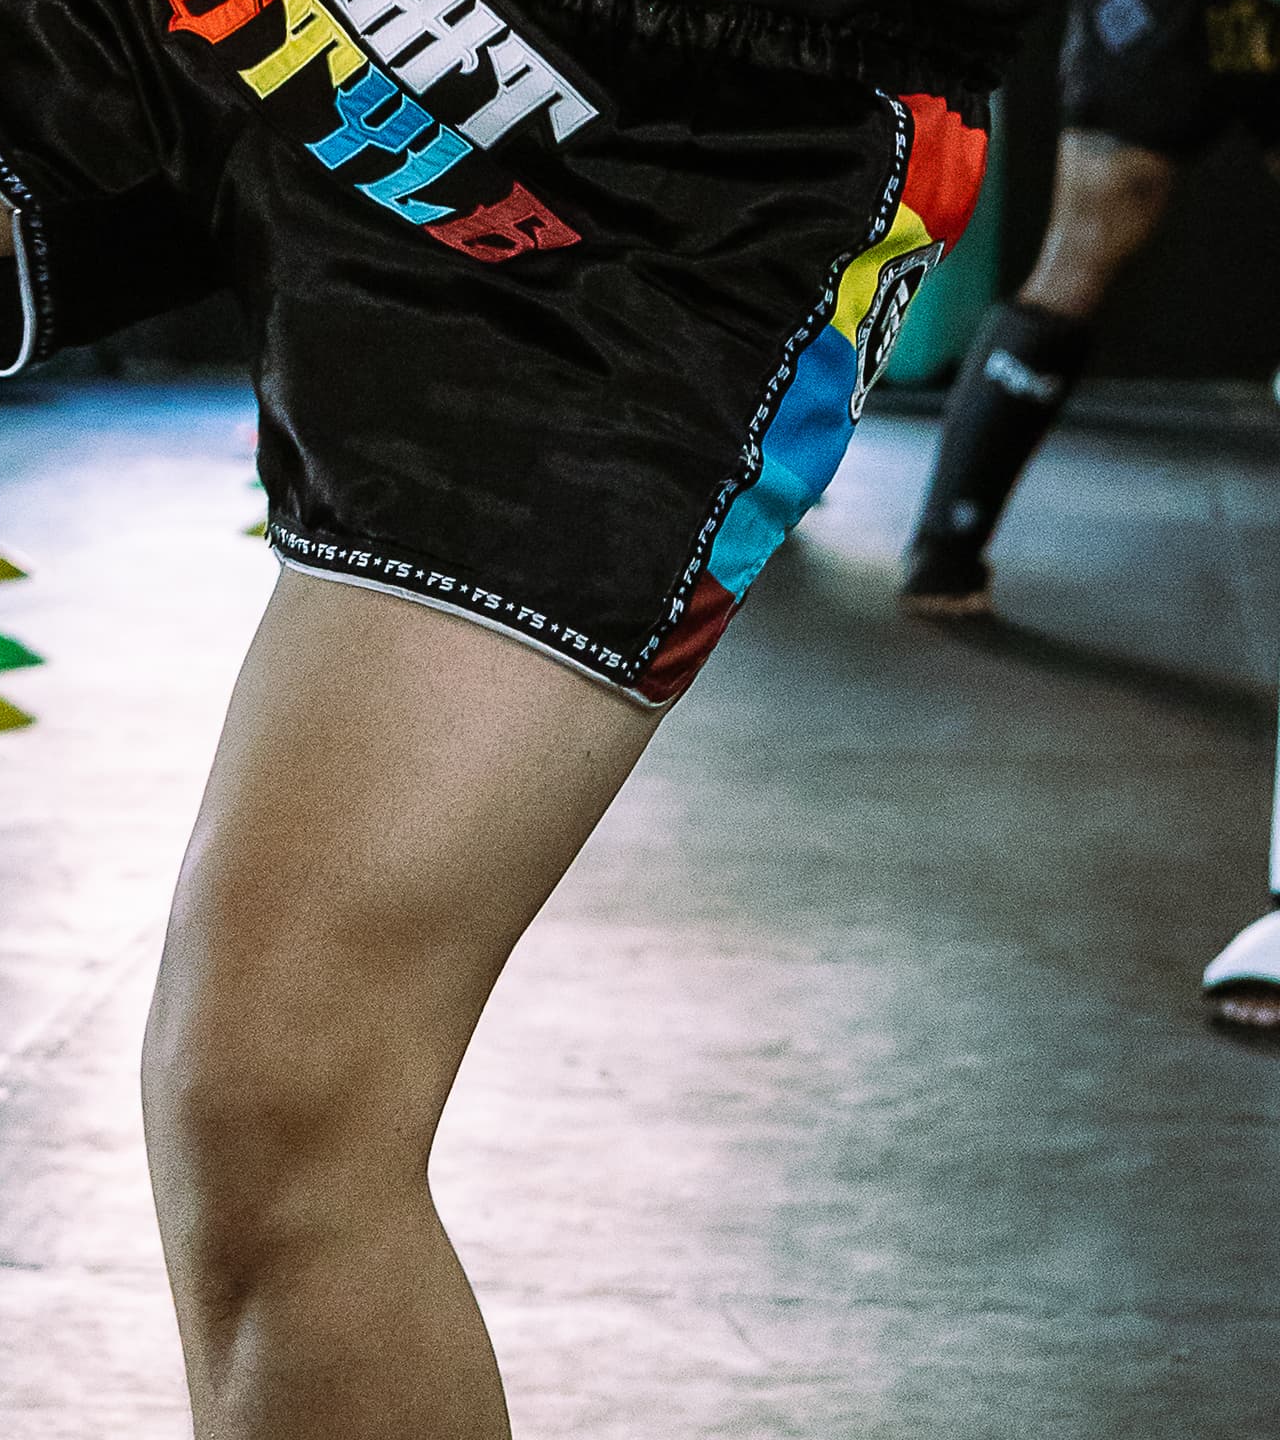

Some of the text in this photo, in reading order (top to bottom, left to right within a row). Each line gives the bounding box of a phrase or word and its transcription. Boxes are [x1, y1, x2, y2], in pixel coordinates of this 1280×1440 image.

[348, 550, 371, 567] FS
[384, 559, 412, 577] FS
[426, 571, 456, 591] FS
[471, 588, 501, 610] FS
[517, 606, 546, 629] FS
[560, 628, 590, 650] FS
